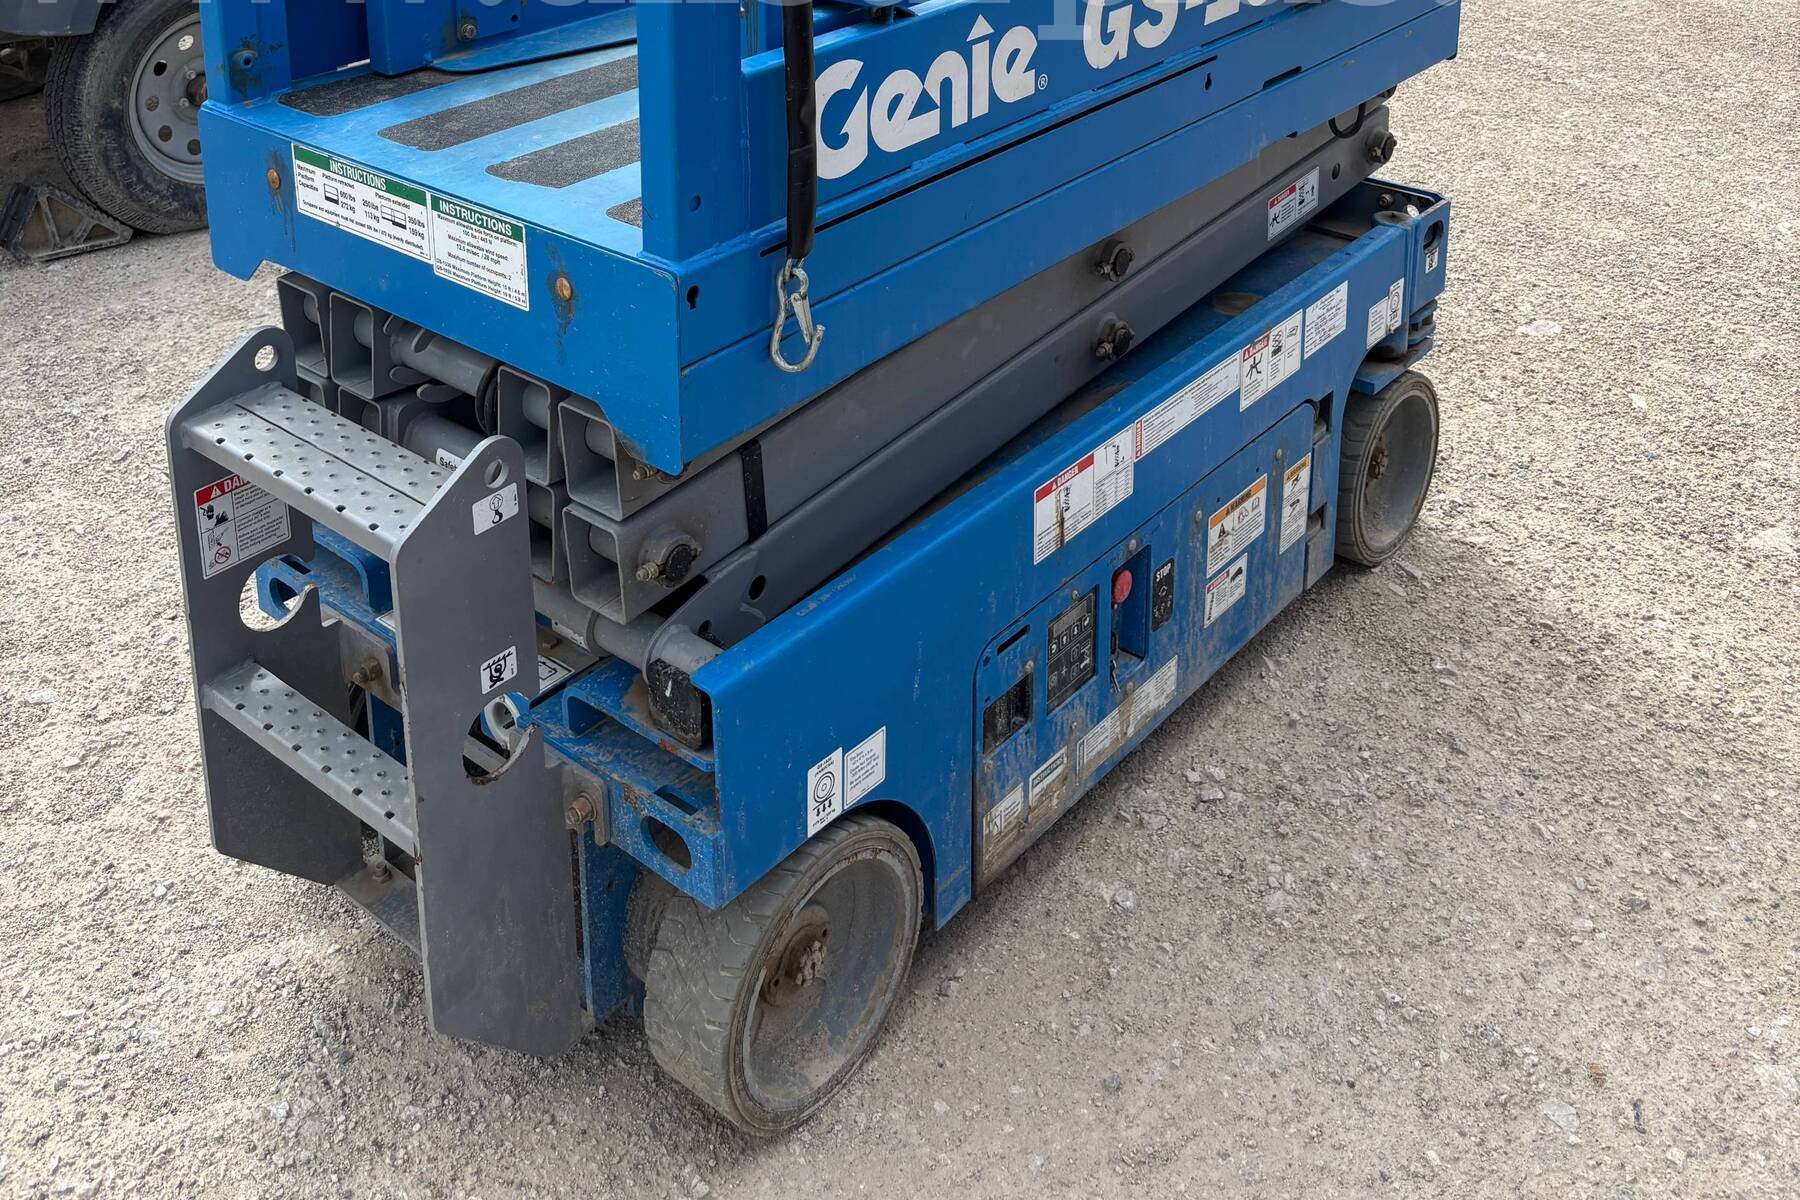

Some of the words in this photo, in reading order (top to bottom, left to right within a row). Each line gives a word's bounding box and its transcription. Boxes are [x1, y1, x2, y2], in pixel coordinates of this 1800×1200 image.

[329, 159, 386, 191] INSTRUCTIONS
[440, 200, 512, 236] INSTRUCTIONS
[440, 456, 458, 472] Safet
[223, 475, 248, 492] DAN
[1057, 465, 1079, 486] DANGER
